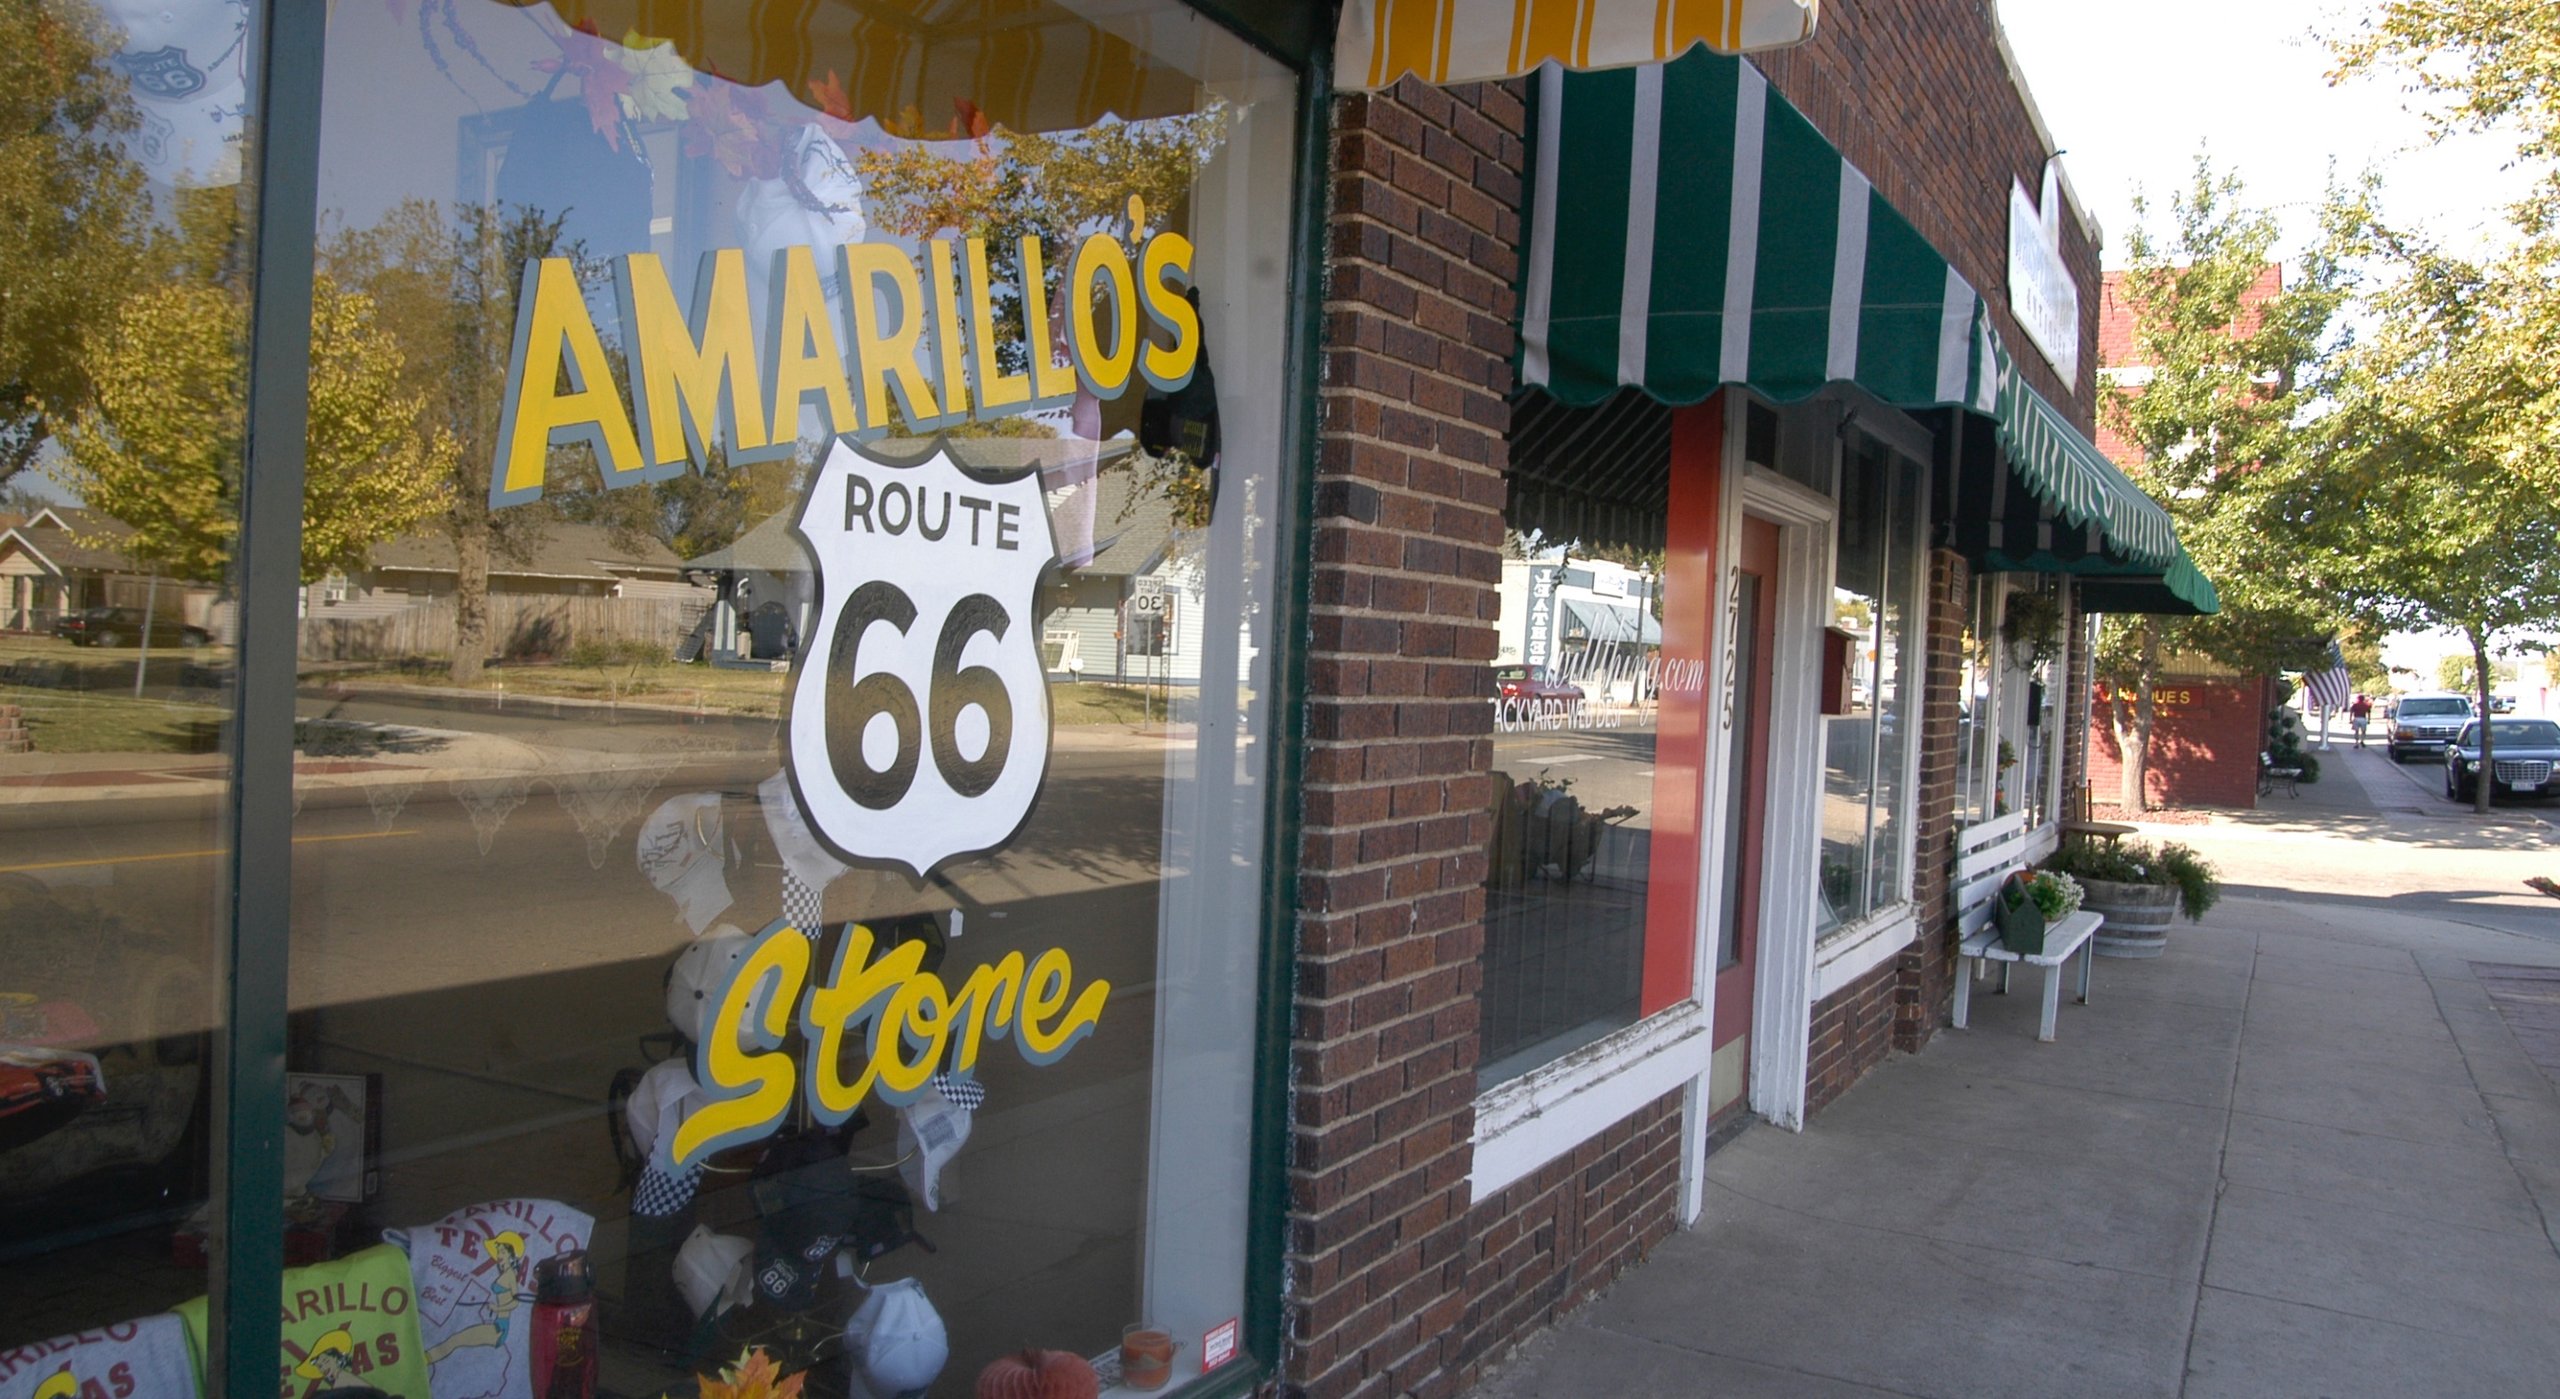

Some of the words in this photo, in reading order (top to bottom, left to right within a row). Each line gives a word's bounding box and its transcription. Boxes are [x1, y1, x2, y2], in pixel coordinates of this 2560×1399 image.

[137, 69, 194, 92] 66
[490, 194, 1200, 508] AMARILLO'S
[844, 472, 1021, 551] ROUTE
[1722, 564, 1741, 731] 2725
[825, 580, 1013, 811] 66
[1494, 698, 1563, 733] ACKYARD
[1566, 698, 1593, 730] WEB
[664, 918, 1111, 1180] Store
[434, 1218, 540, 1293] TEXA
[446, 1200, 579, 1254] ARILLO
[421, 1286, 447, 1306] Best
[431, 1254, 469, 1281] Biggest
[763, 1270, 787, 1294] 66
